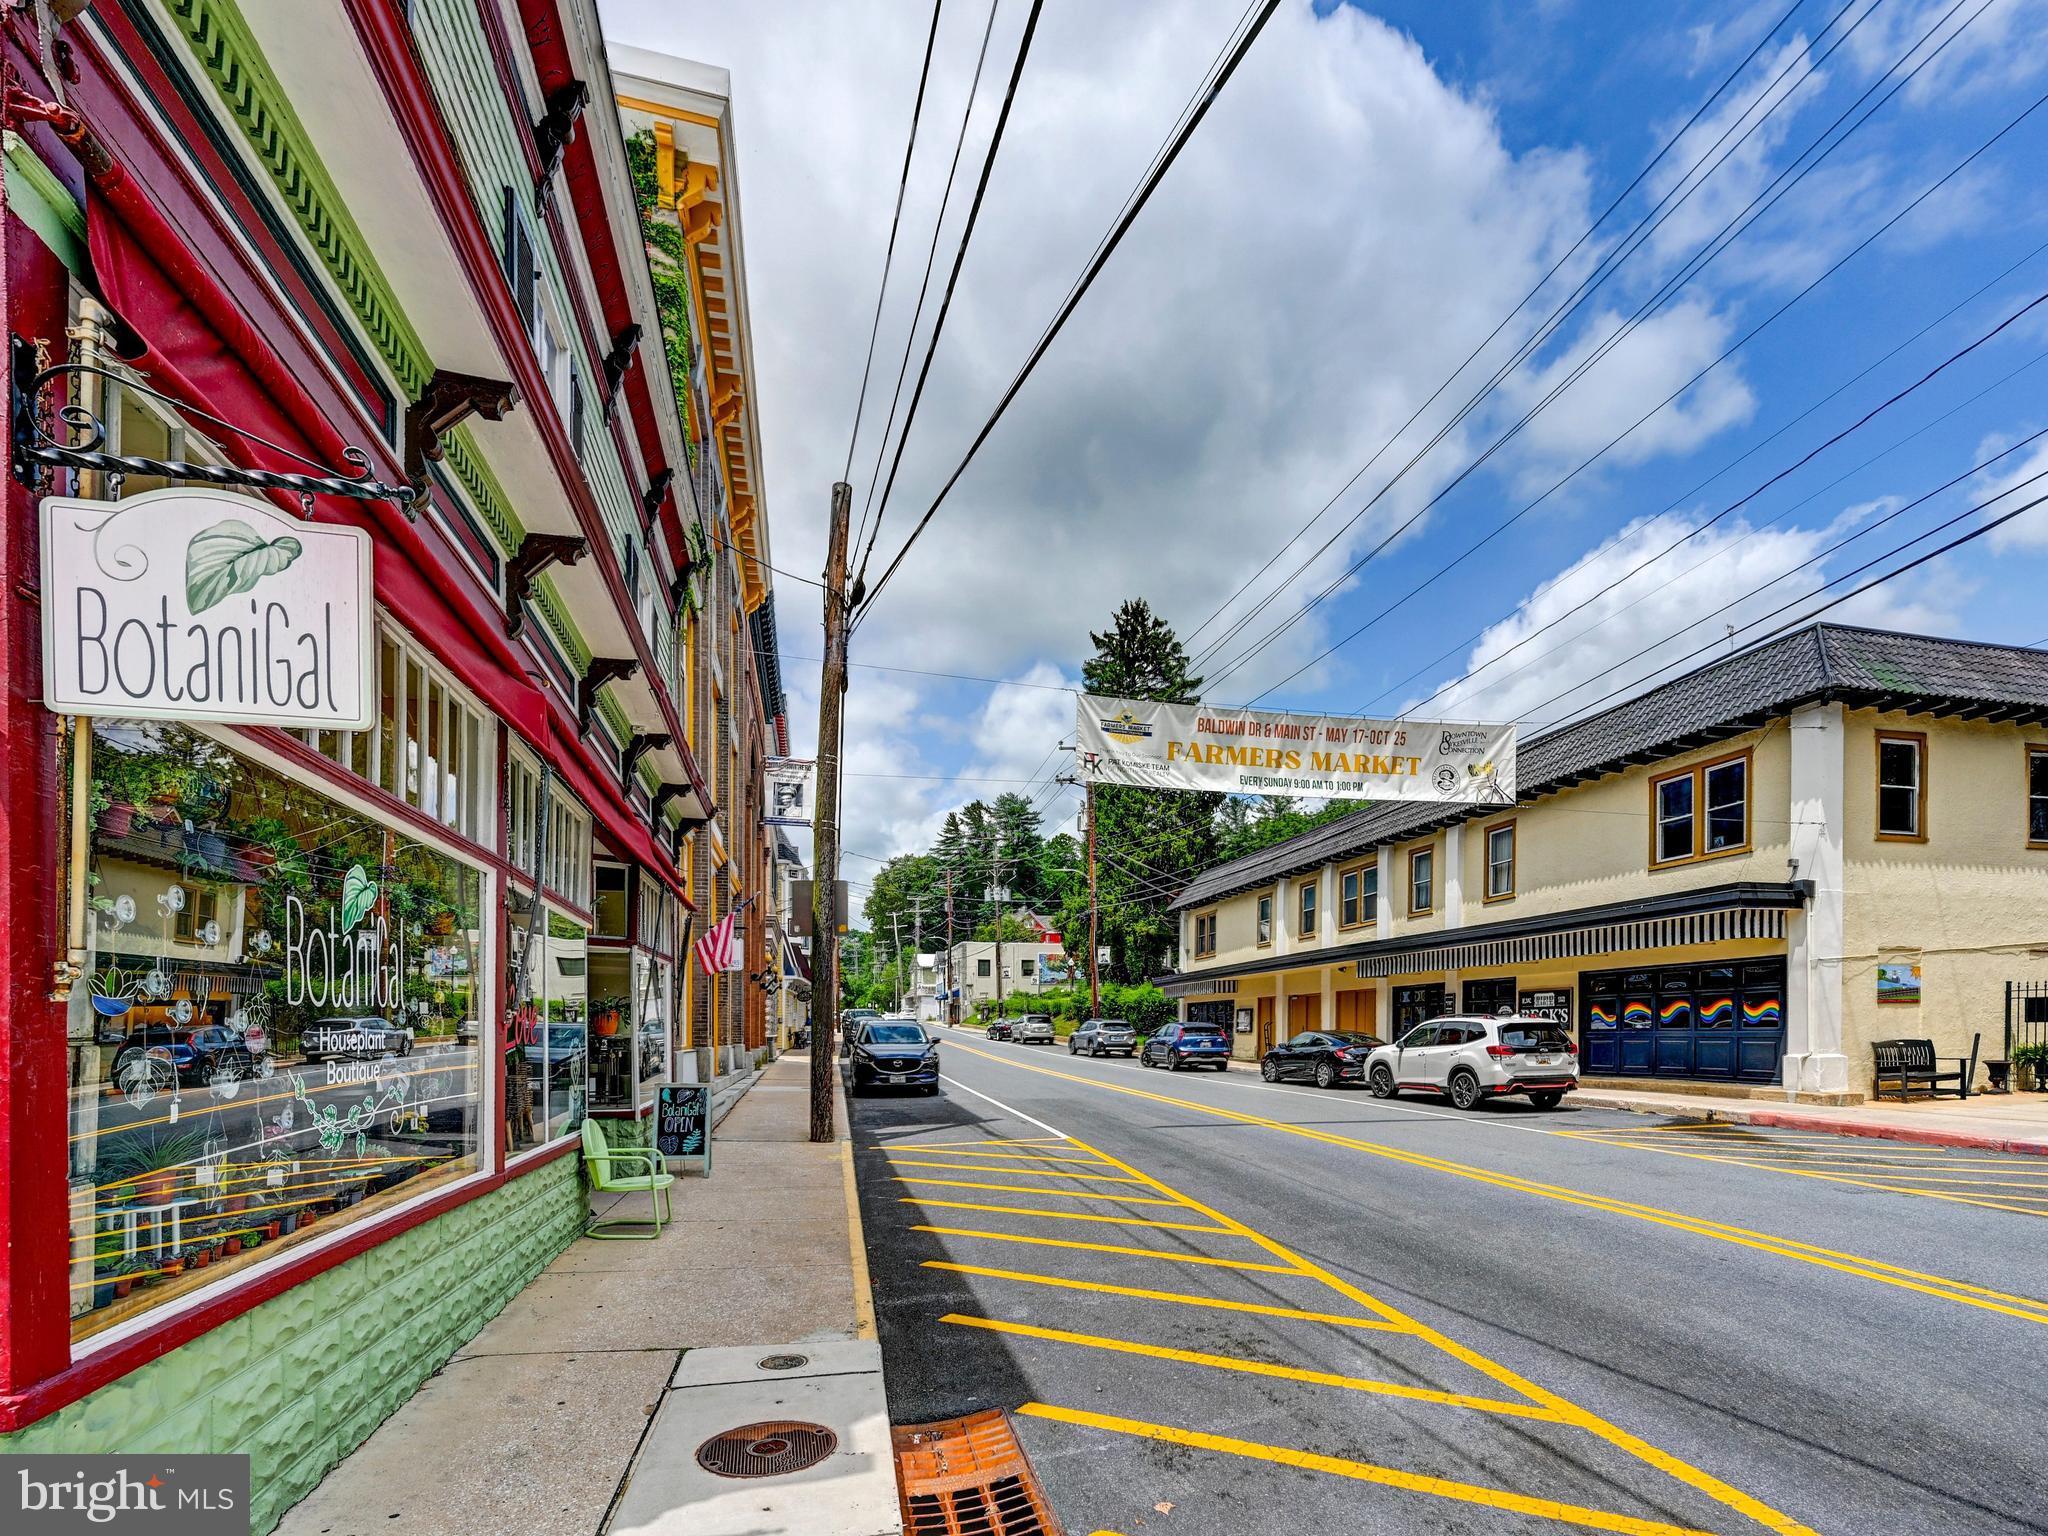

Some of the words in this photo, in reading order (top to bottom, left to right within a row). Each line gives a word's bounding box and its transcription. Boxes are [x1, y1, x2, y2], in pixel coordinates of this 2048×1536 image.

[76, 586, 338, 713] BotaniGal
[1197, 717, 1245, 736] BALDWIN
[1248, 721, 1262, 737] DR
[1264, 723, 1271, 738] &
[1274, 724, 1300, 740] MAIN
[1302, 726, 1316, 741] ST
[1325, 727, 1348, 743] MAY
[1352, 729, 1390, 745] 17-OCT
[1393, 731, 1407, 746] 25
[1442, 730, 1488, 742] DOWNTOWN
[1151, 763, 1170, 771] TEAM
[1167, 741, 1301, 769] FARMERS
[1310, 751, 1422, 776] MARKET
[1239, 775, 1262, 786] EVERY
[1263, 777, 1293, 788] SUNDAY
[1294, 779, 1310, 789] 9:00
[1311, 780, 1323, 790] AM
[1325, 781, 1334, 791] TO
[1336, 781, 1351, 791] 1:00
[1352, 782, 1364, 792] PM
[286, 895, 406, 1010] BotaniGal
[1520, 1007, 1569, 1023] BECK'S
[319, 1026, 386, 1058] Houseplant
[327, 1060, 380, 1086] Boutique
[664, 1116, 695, 1133] OPEN
